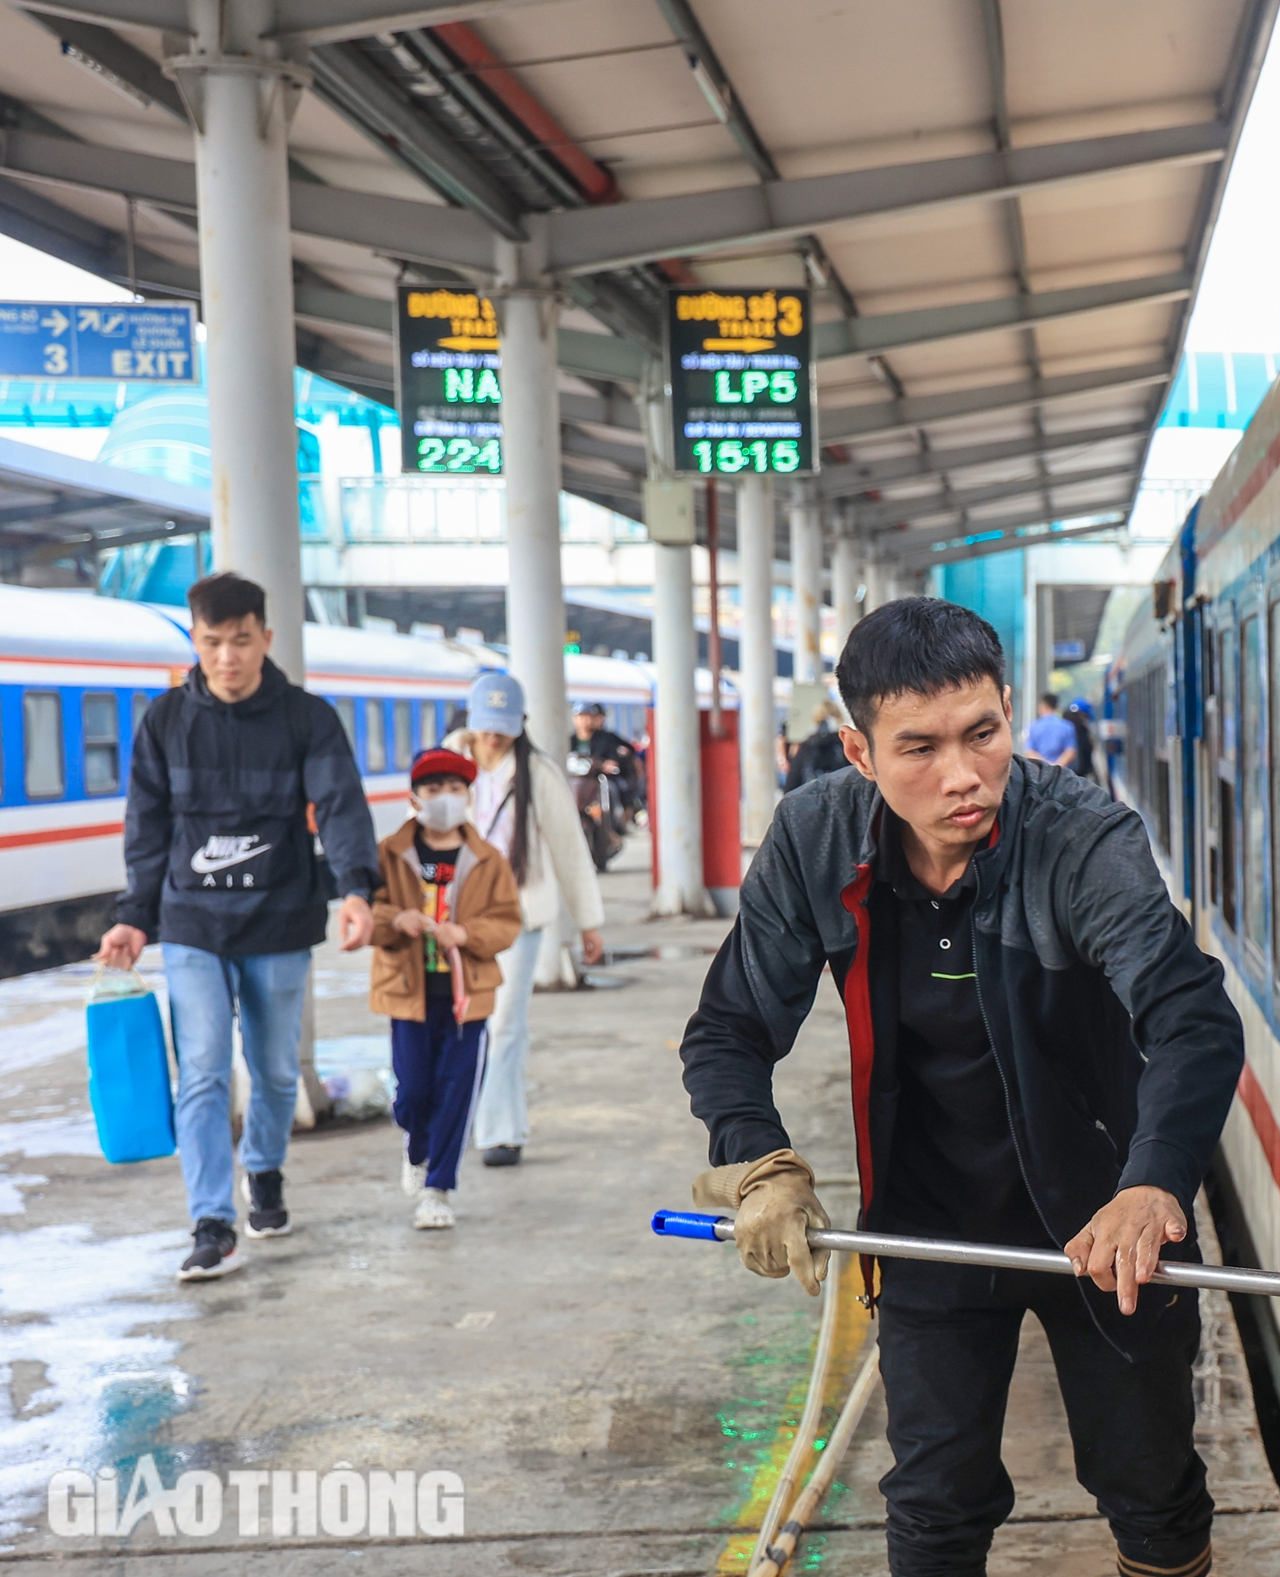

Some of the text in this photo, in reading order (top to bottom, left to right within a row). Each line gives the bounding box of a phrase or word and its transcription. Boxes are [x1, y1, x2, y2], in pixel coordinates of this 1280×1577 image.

[778, 296, 803, 337] 3
[43, 342, 69, 375] 3
[112, 349, 189, 377] EXIT
[715, 370, 798, 403] LP5
[204, 835, 254, 858] NIKE
[202, 873, 254, 888] AIR
